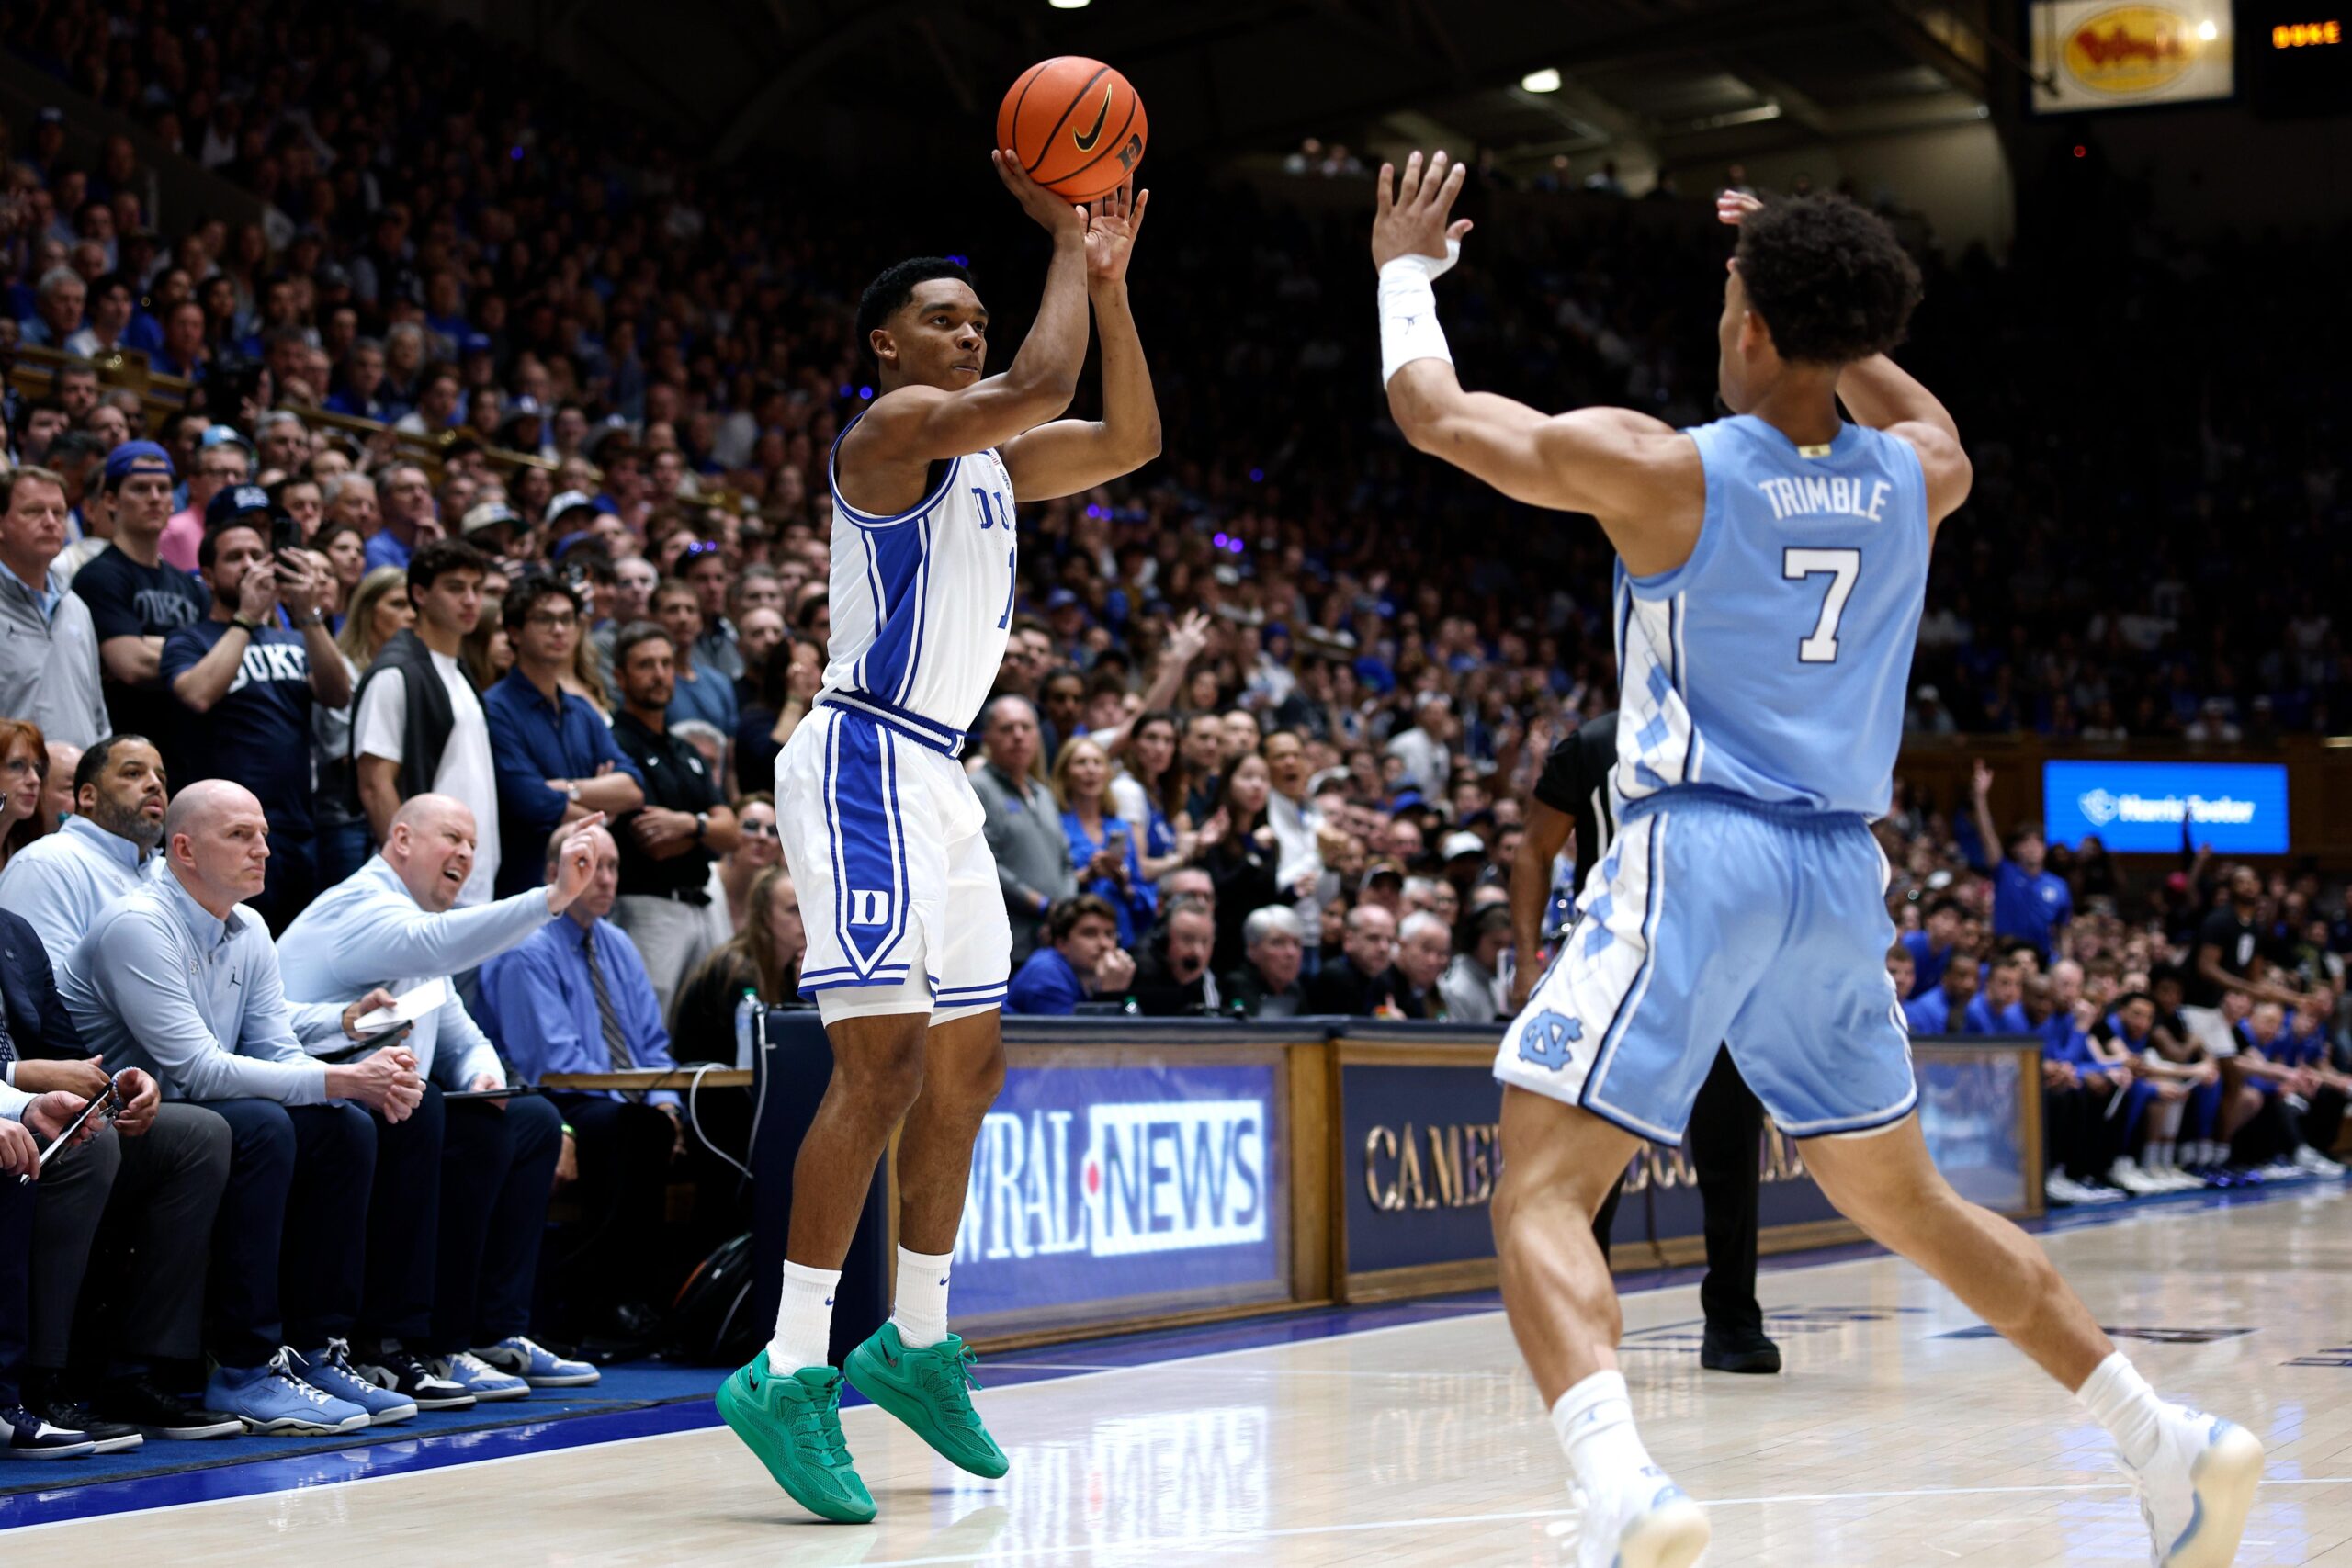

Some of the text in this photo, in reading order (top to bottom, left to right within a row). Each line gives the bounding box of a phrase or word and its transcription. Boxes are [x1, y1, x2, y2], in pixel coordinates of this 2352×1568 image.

[1758, 476, 1892, 523] TRIMBLE
[1782, 547, 1861, 662] 7
[850, 889, 889, 925] D
[1102, 1117, 1259, 1238] NEWS
[1365, 1122, 1500, 1211] CAME
